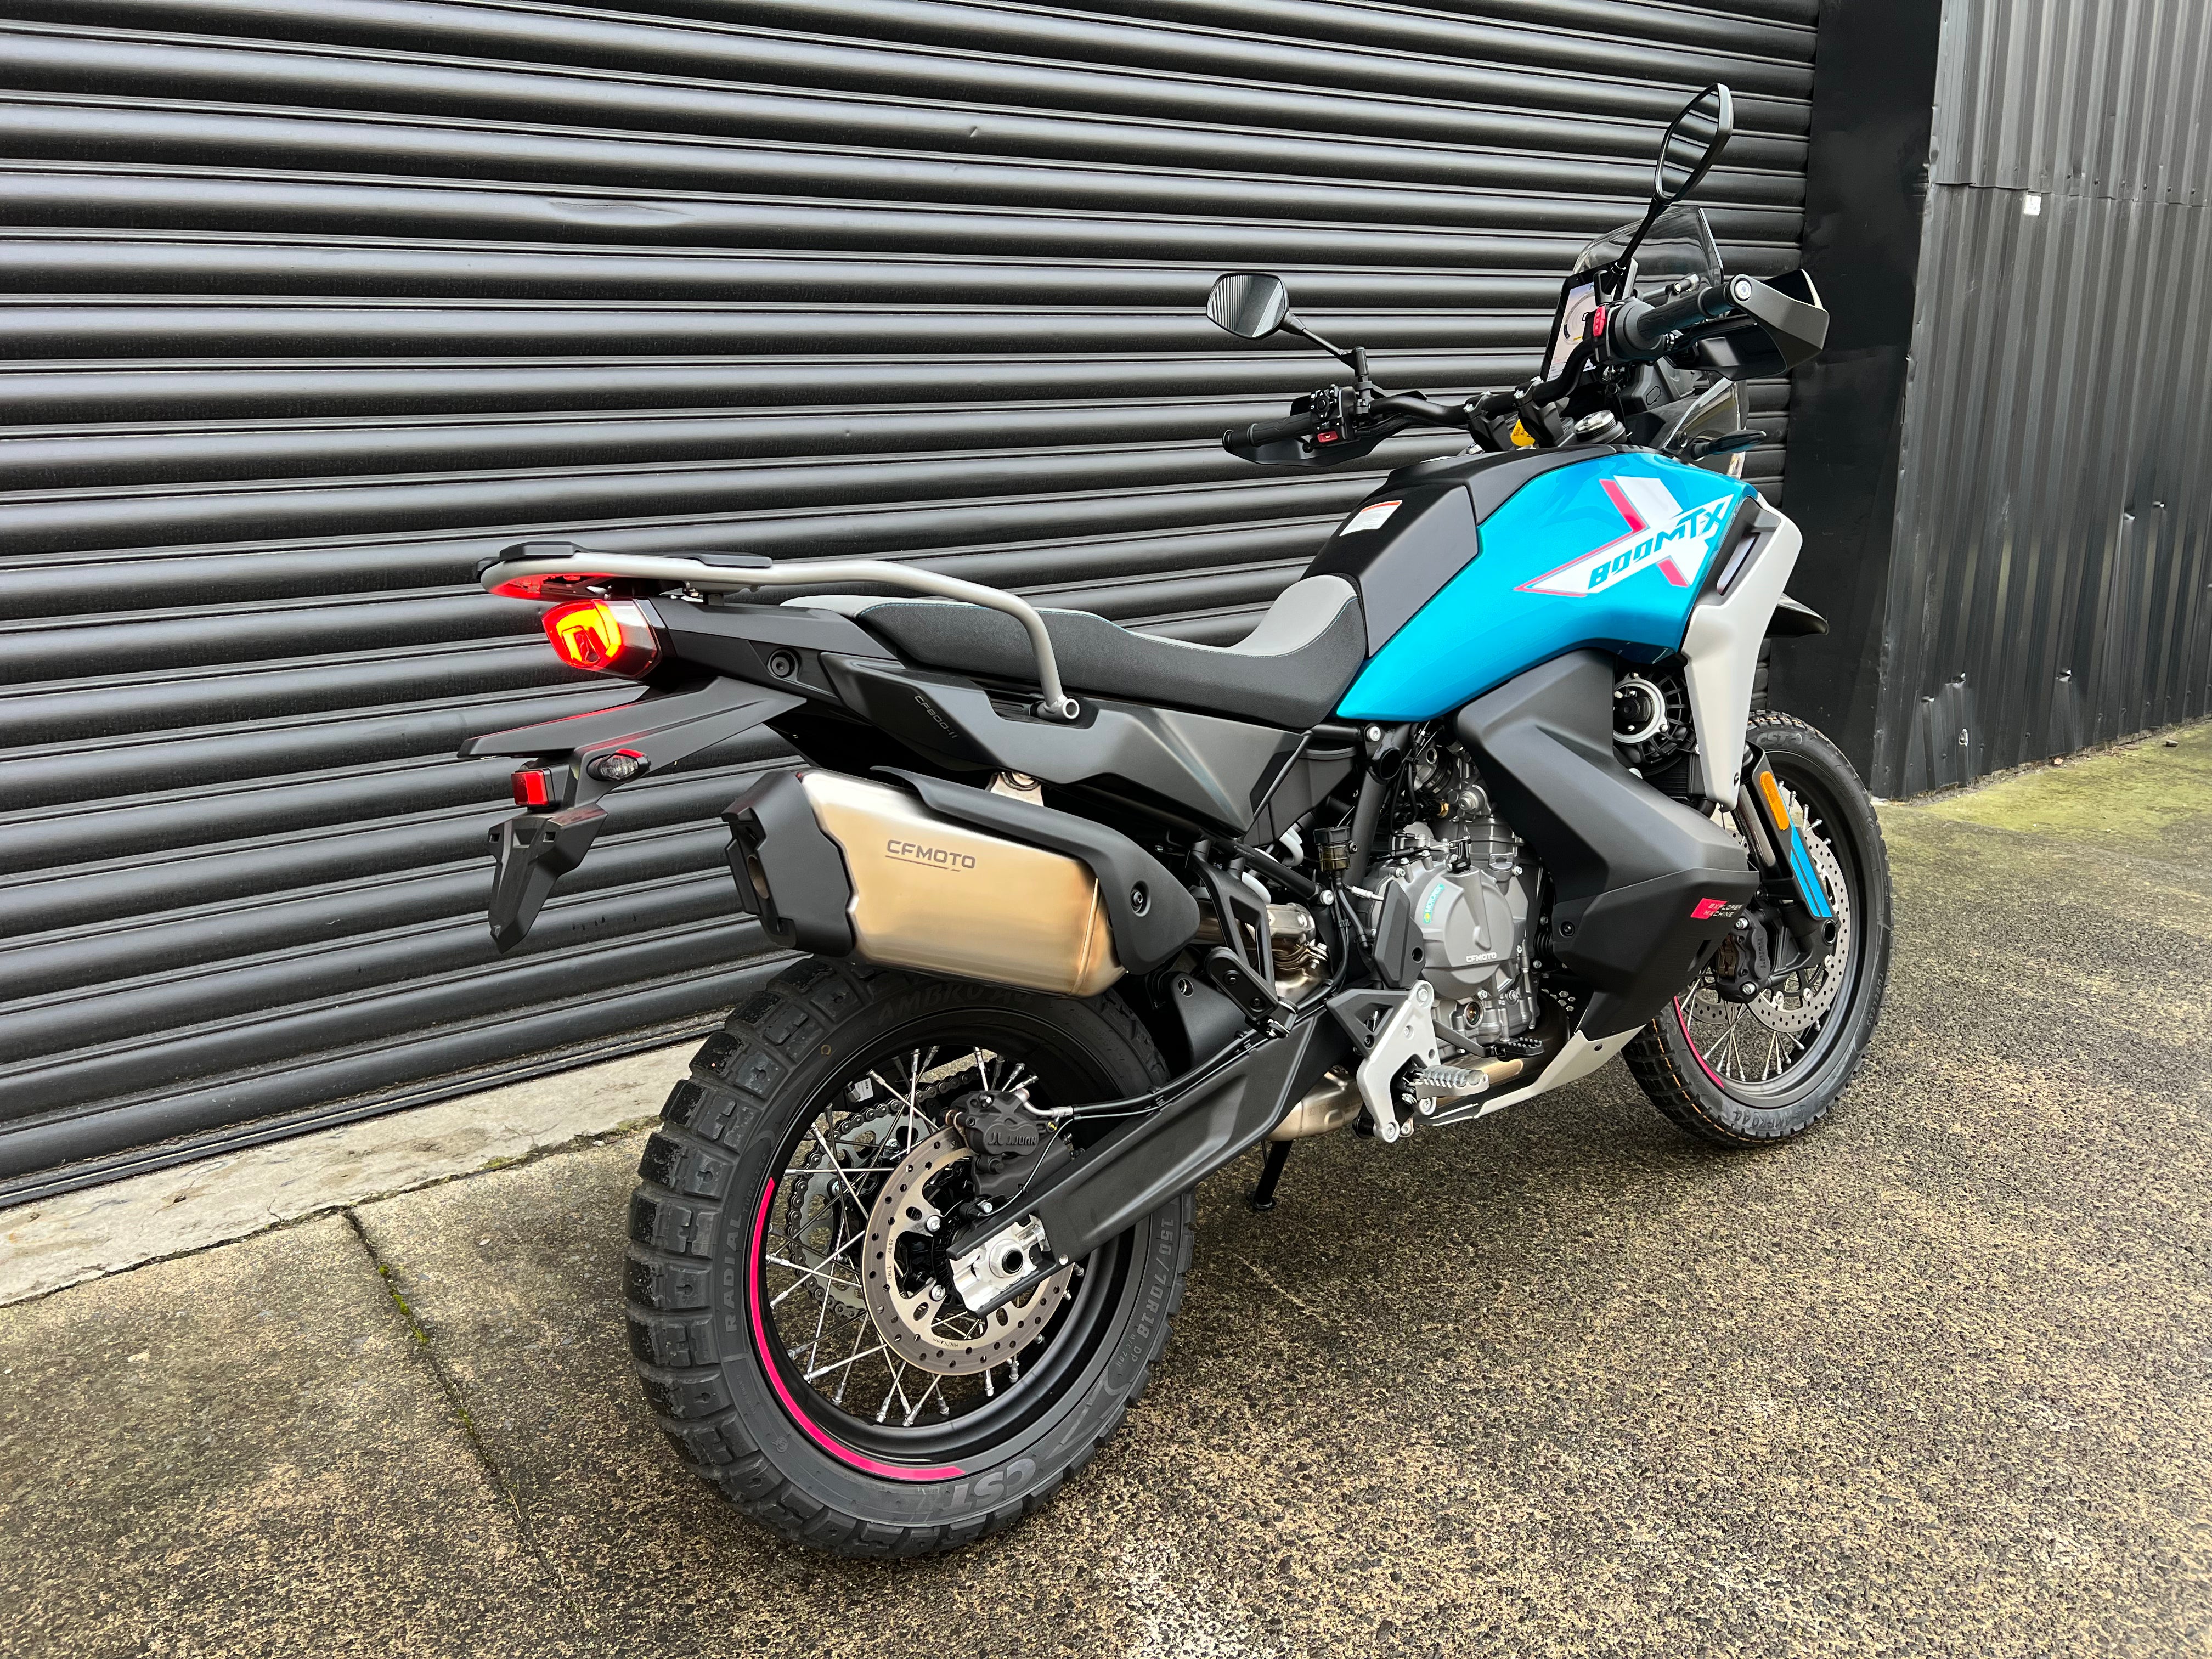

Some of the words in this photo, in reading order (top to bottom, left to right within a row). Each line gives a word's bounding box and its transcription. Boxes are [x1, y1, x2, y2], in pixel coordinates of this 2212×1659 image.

[914, 695, 958, 738] CF800-11
[887, 839, 976, 870] CFMOTO
[1465, 952, 1497, 963] CFMOTO
[1866, 972, 1884, 1028] TUBELESS
[723, 1214, 743, 1333] RADIAL
[742, 1152, 768, 1213] TUBELESS
[1136, 1217, 1175, 1339] 150/70R18
[1125, 1333, 1136, 1349] M/C
[1130, 1345, 1143, 1362] DP
[943, 1458, 1036, 1510] CST
